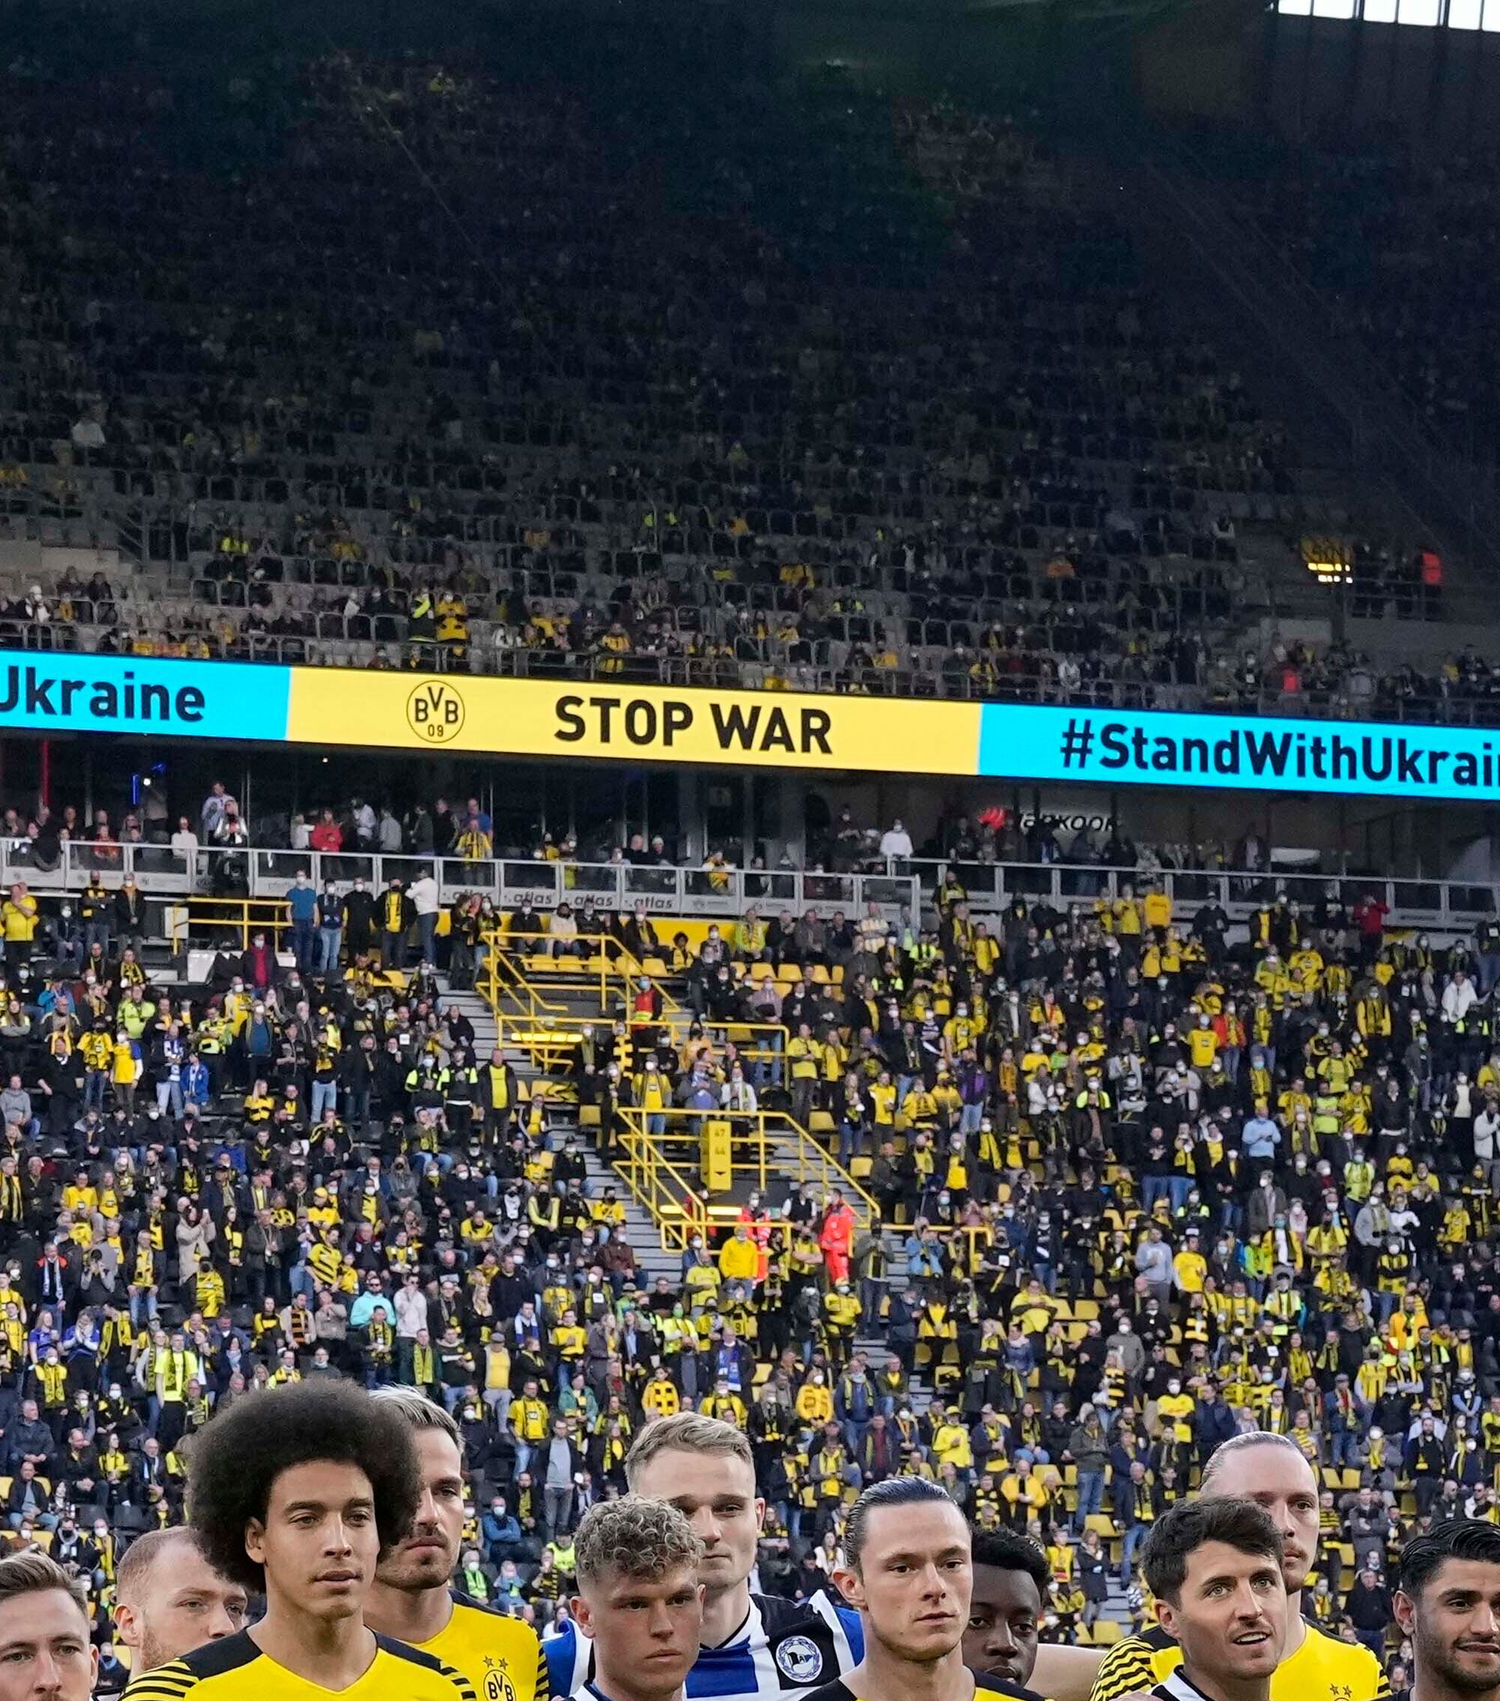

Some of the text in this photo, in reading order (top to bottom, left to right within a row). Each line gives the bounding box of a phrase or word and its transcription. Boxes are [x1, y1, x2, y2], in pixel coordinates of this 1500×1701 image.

[414, 685, 460, 724] BVB
[427, 723, 445, 737] 09
[552, 695, 834, 755] STOP WAR
[487, 1674, 514, 1700] BVB
